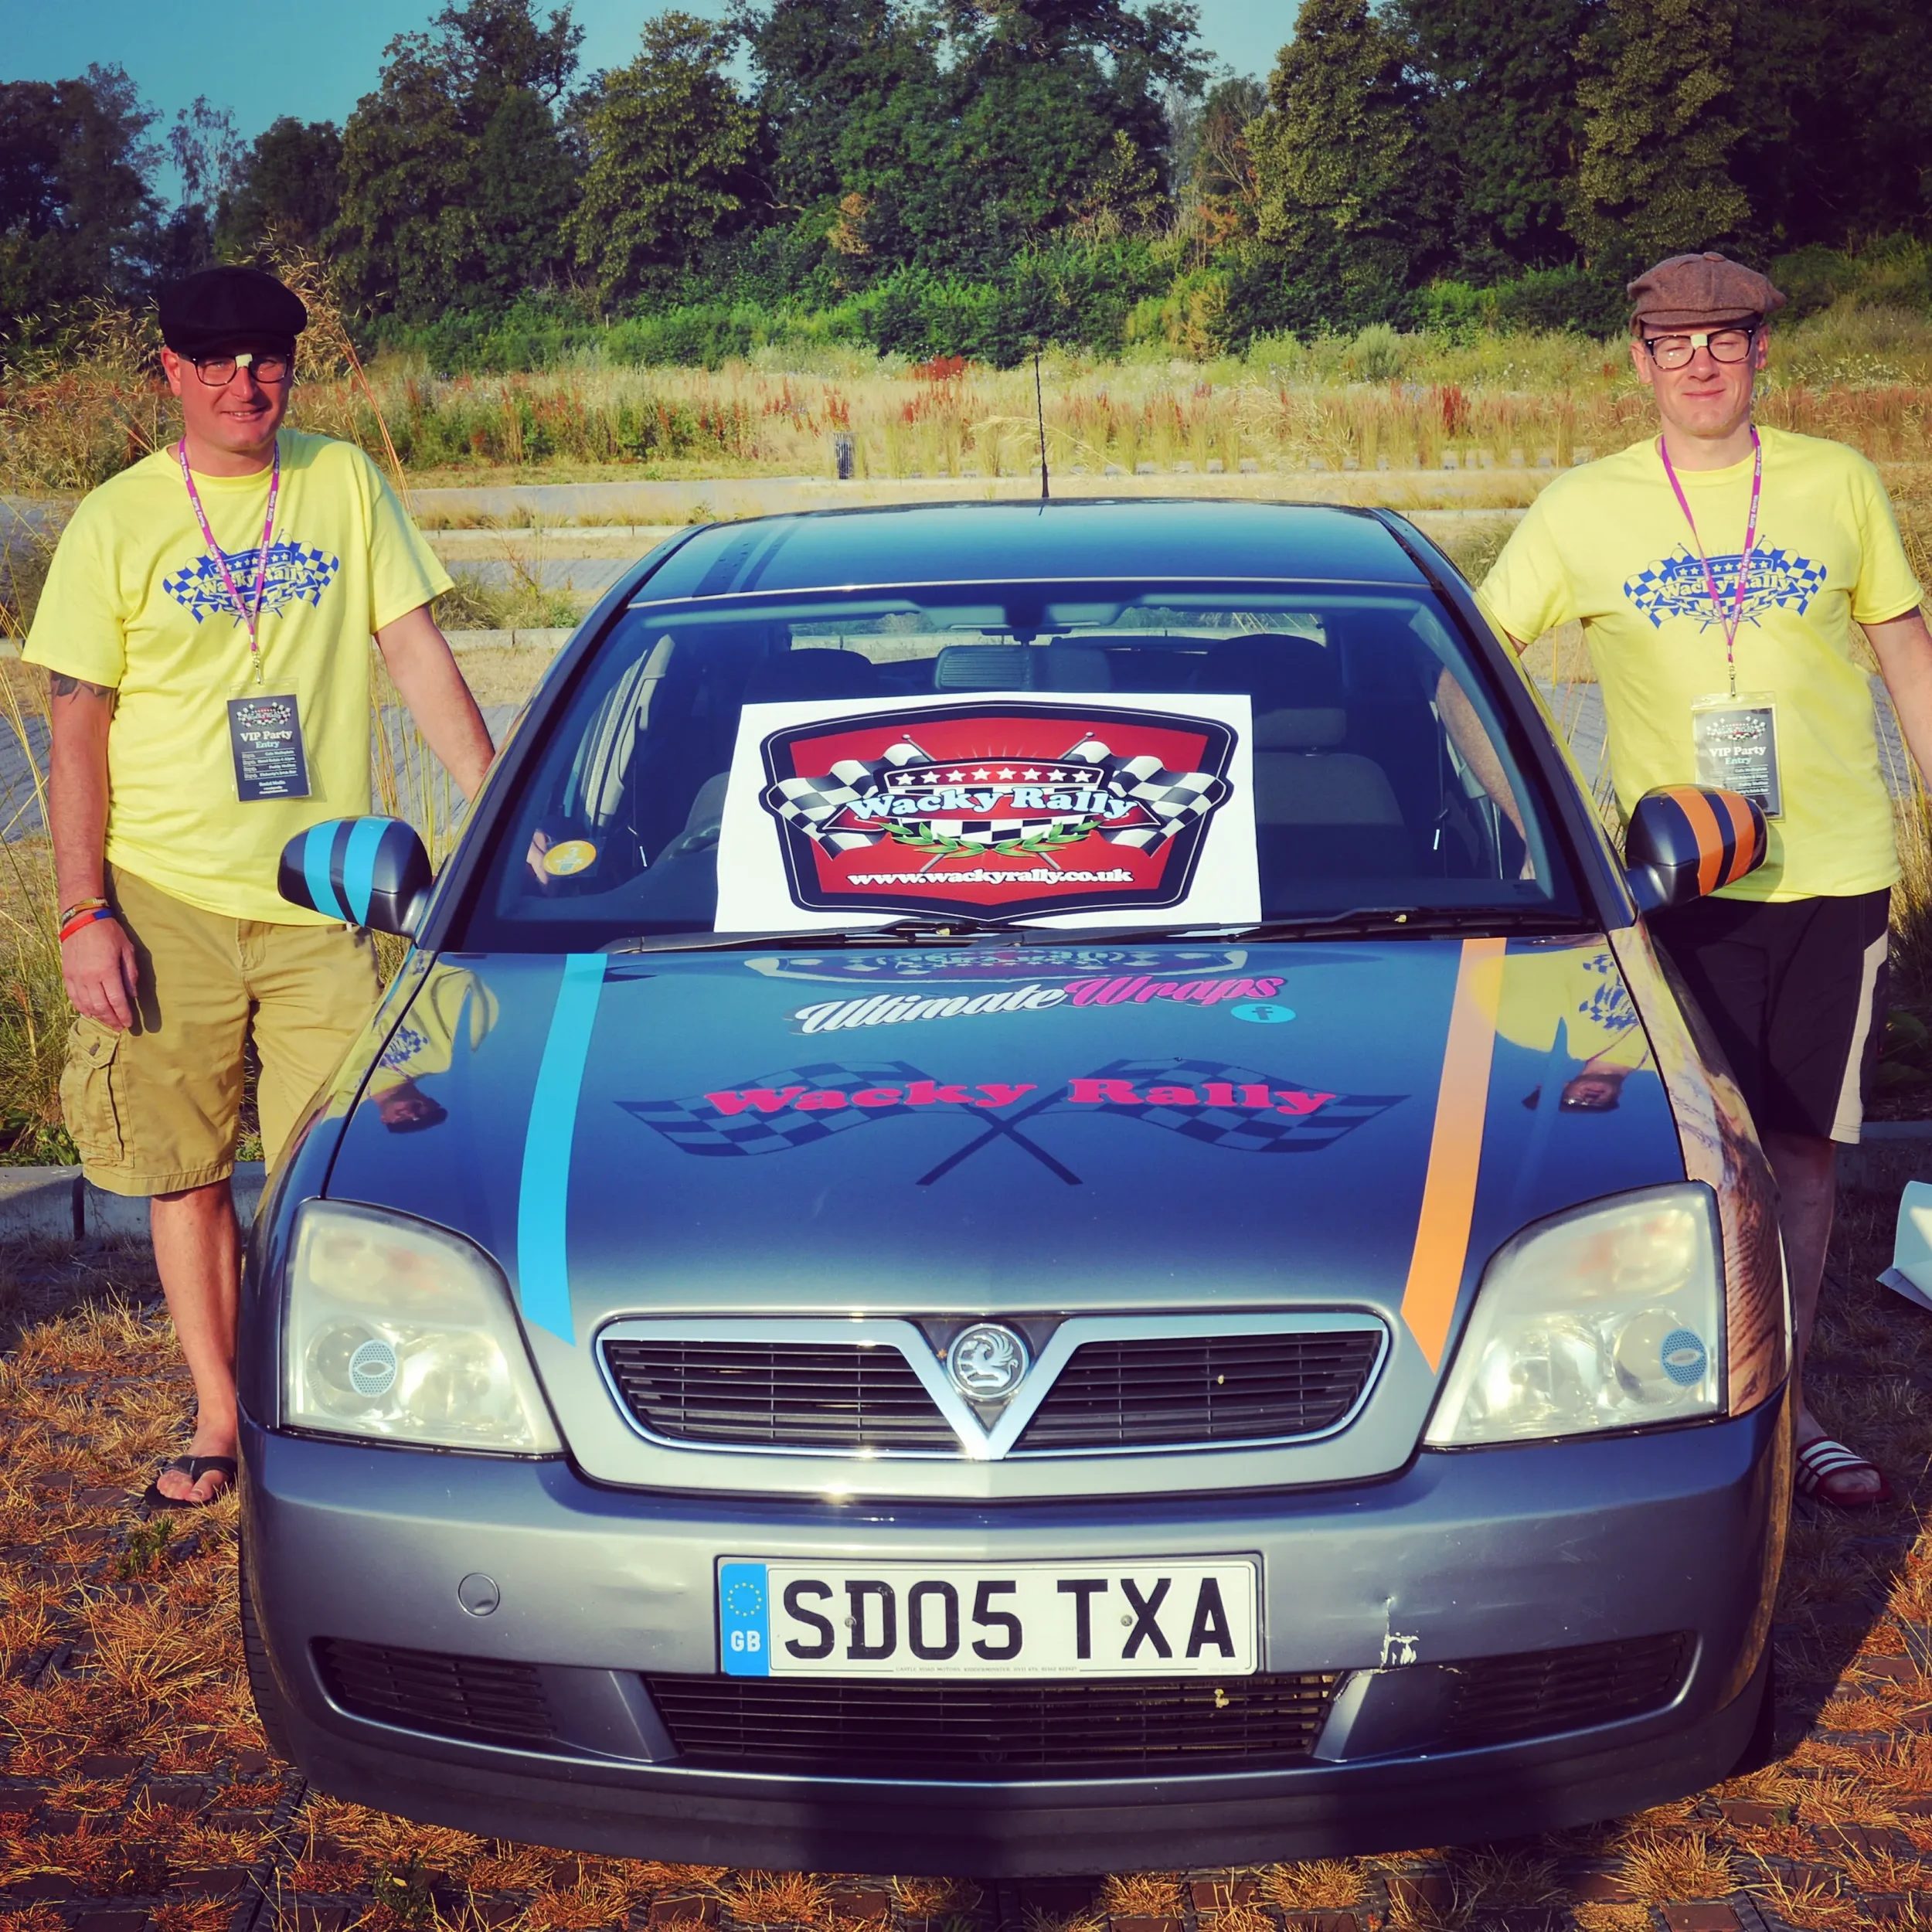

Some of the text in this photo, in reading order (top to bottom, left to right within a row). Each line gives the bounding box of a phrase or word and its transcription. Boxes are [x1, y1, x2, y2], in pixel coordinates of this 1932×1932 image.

[198, 570, 256, 596] Waky
[240, 730, 293, 742] VIP Party
[1709, 746, 1767, 757] VIP Party
[1725, 757, 1752, 765] Entry
[845, 787, 1138, 820] Wacky Rally
[847, 868, 1134, 886] www.wackyrally.co.uk
[796, 983, 1067, 1034] Ultimate
[704, 1079, 1337, 1115] Wacky Rally
[784, 1577, 1236, 1660] SD05 TXA
[730, 1630, 760, 1652] GB
